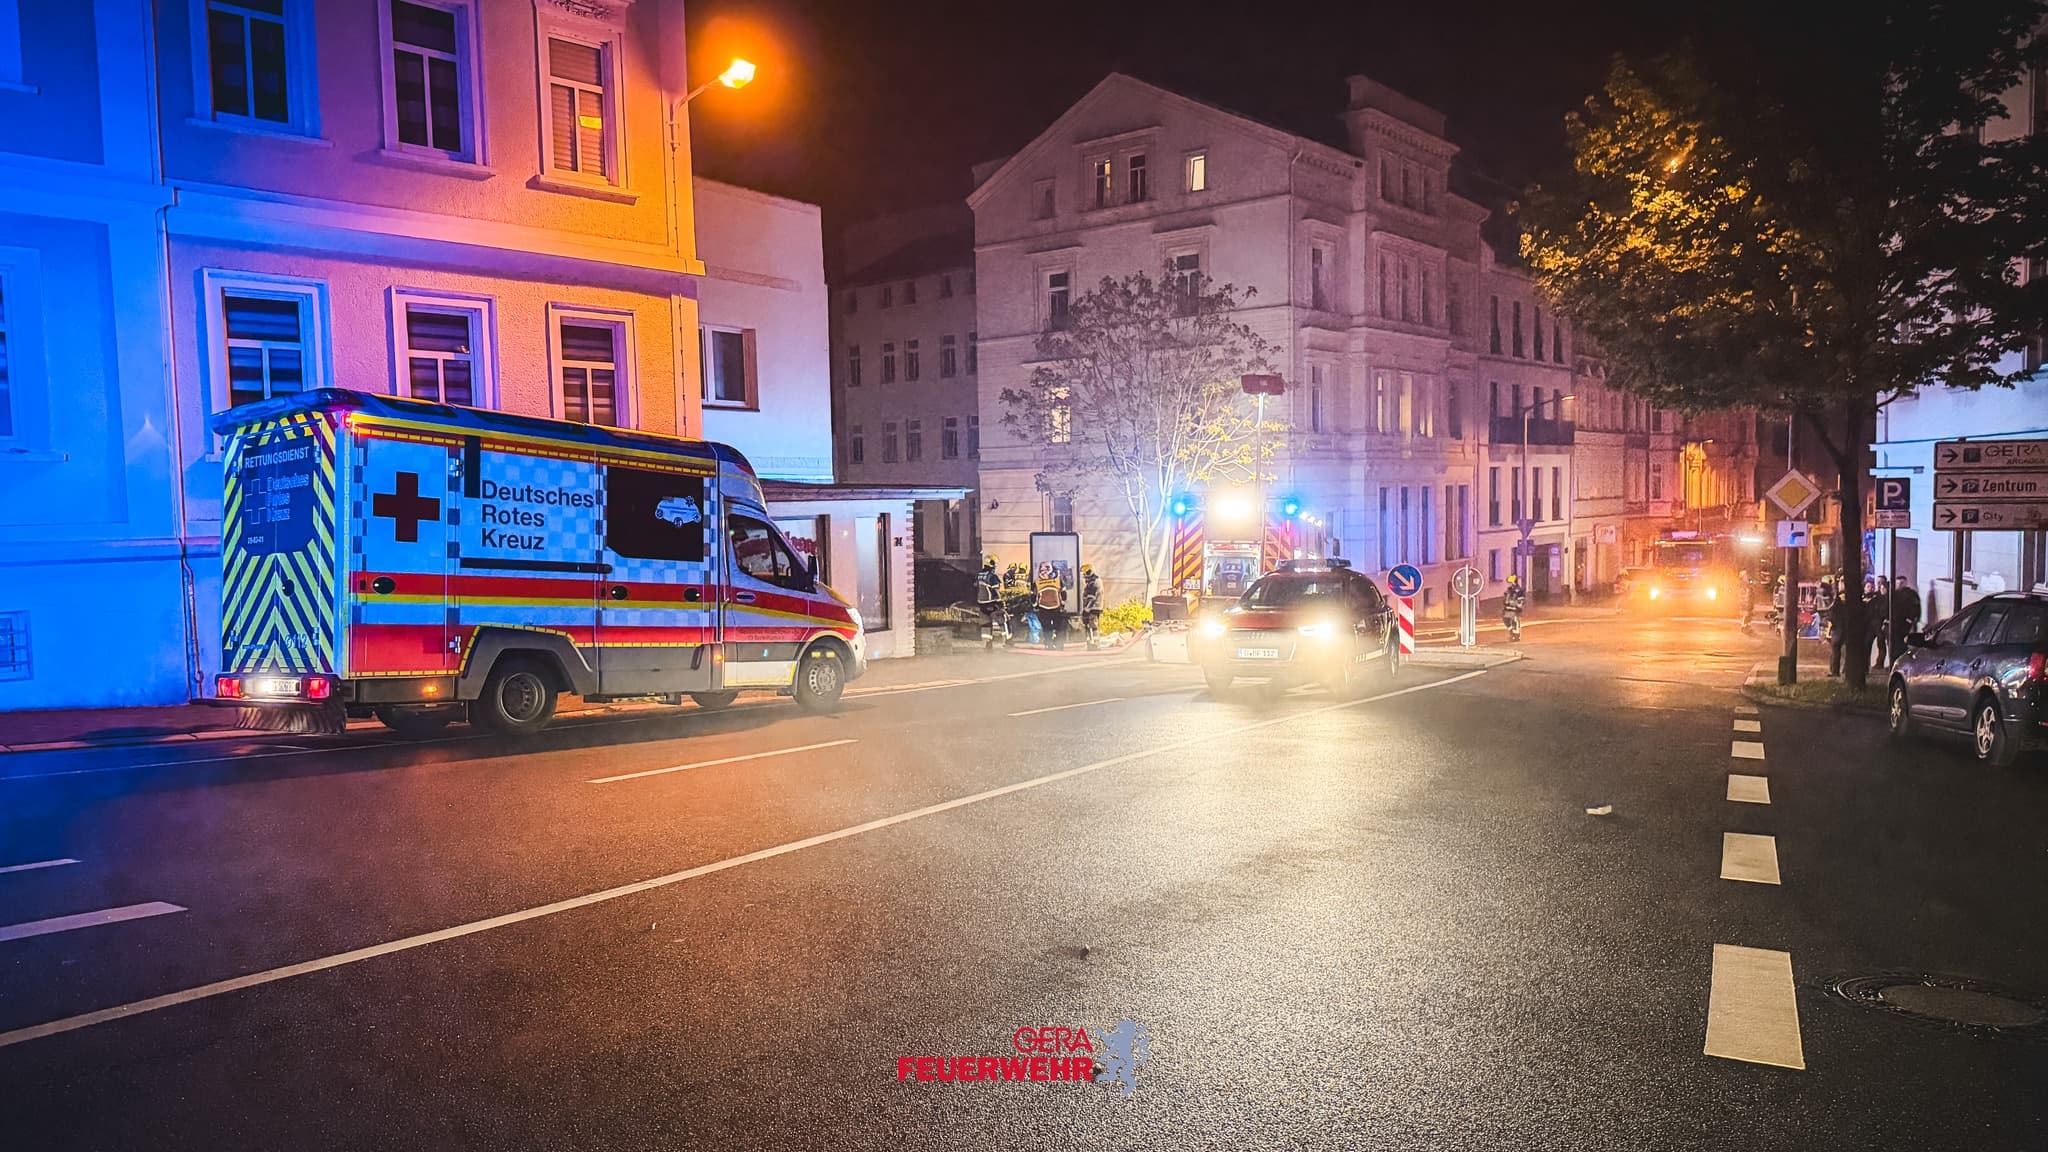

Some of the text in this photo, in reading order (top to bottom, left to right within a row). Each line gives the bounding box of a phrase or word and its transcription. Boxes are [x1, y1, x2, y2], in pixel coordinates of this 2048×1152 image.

[244, 446, 310, 469] RETTUNGSDIENST
[1984, 444, 2042, 457] GERA
[481, 479, 594, 508] Deutsches
[1883, 481, 1903, 506] P
[1982, 479, 2037, 493] Zentrum
[481, 503, 545, 527] Rotes
[1983, 511, 2004, 522] City
[481, 527, 545, 550] Kreuz
